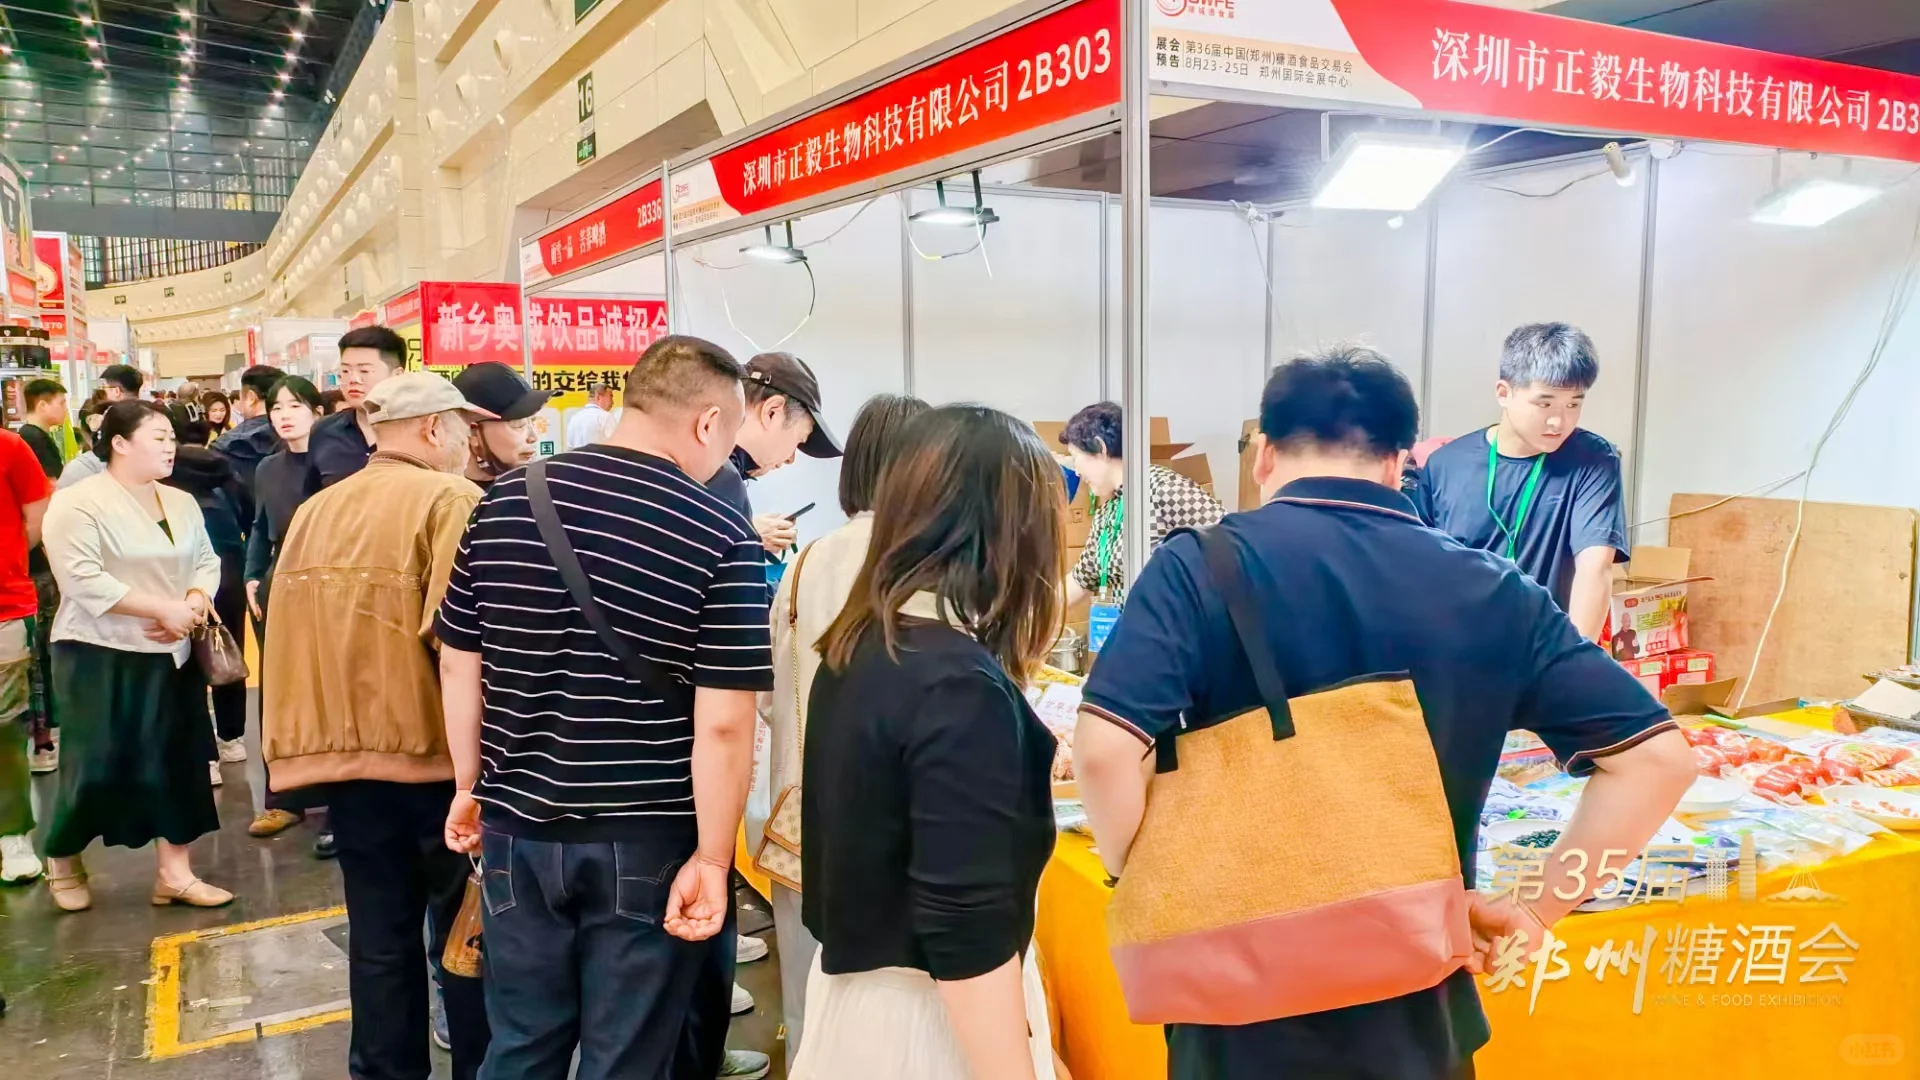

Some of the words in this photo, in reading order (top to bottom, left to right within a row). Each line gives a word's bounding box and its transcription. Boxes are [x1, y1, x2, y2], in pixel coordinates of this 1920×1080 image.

[1156, 36, 1180, 52] 展会
[1156, 52, 1180, 68] 预告
[1259, 66, 1349, 88] 郑州国际会展中心
[1431, 27, 1870, 132] 深圳市正毅生物科技有限公司
[579, 78, 593, 117] 16
[742, 63, 1010, 197] 深圳市正毅生物科技有限公司
[1017, 28, 1112, 101] 2B303
[637, 197, 662, 230] 2B336
